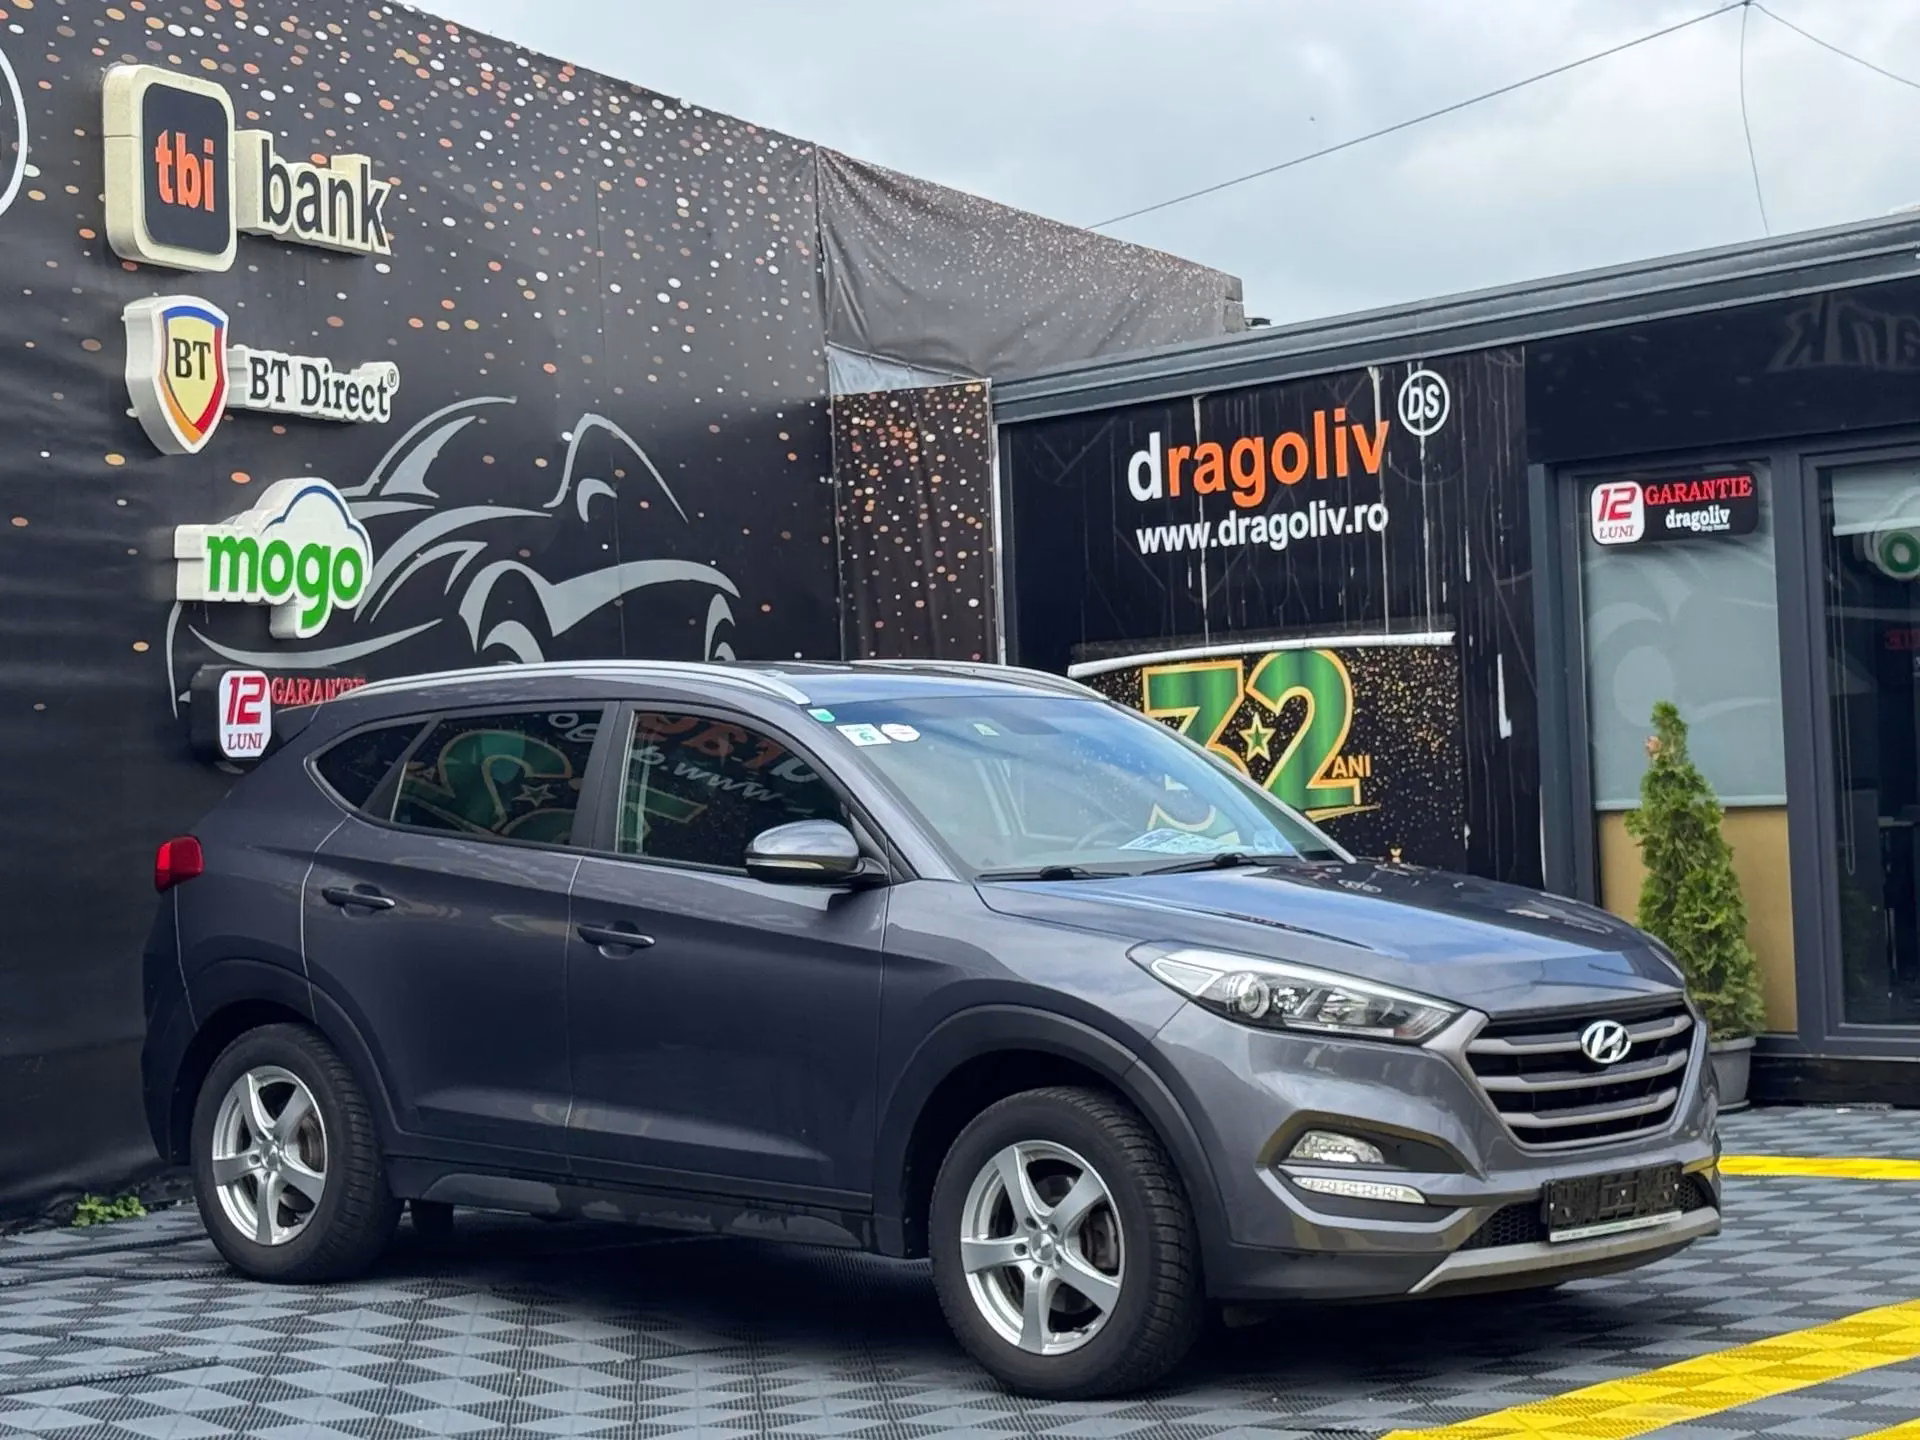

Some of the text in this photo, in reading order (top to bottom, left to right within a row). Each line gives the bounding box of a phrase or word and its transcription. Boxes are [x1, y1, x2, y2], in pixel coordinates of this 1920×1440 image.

[155, 130, 390, 248] tbi bank
[173, 338, 211, 382] BT
[249, 357, 290, 403] BT
[1408, 384, 1440, 421] DS
[1127, 407, 1390, 507] dragoliv
[1598, 475, 1753, 522] 12 GARANTIE
[1665, 504, 1731, 532] dragoliv
[1136, 500, 1389, 554] www.dragoliv.ro
[1599, 524, 1635, 540] LUNI
[207, 535, 363, 630] mogo
[226, 676, 266, 725] 12
[227, 732, 264, 751] LUNI
[1331, 754, 1372, 778] ANI
